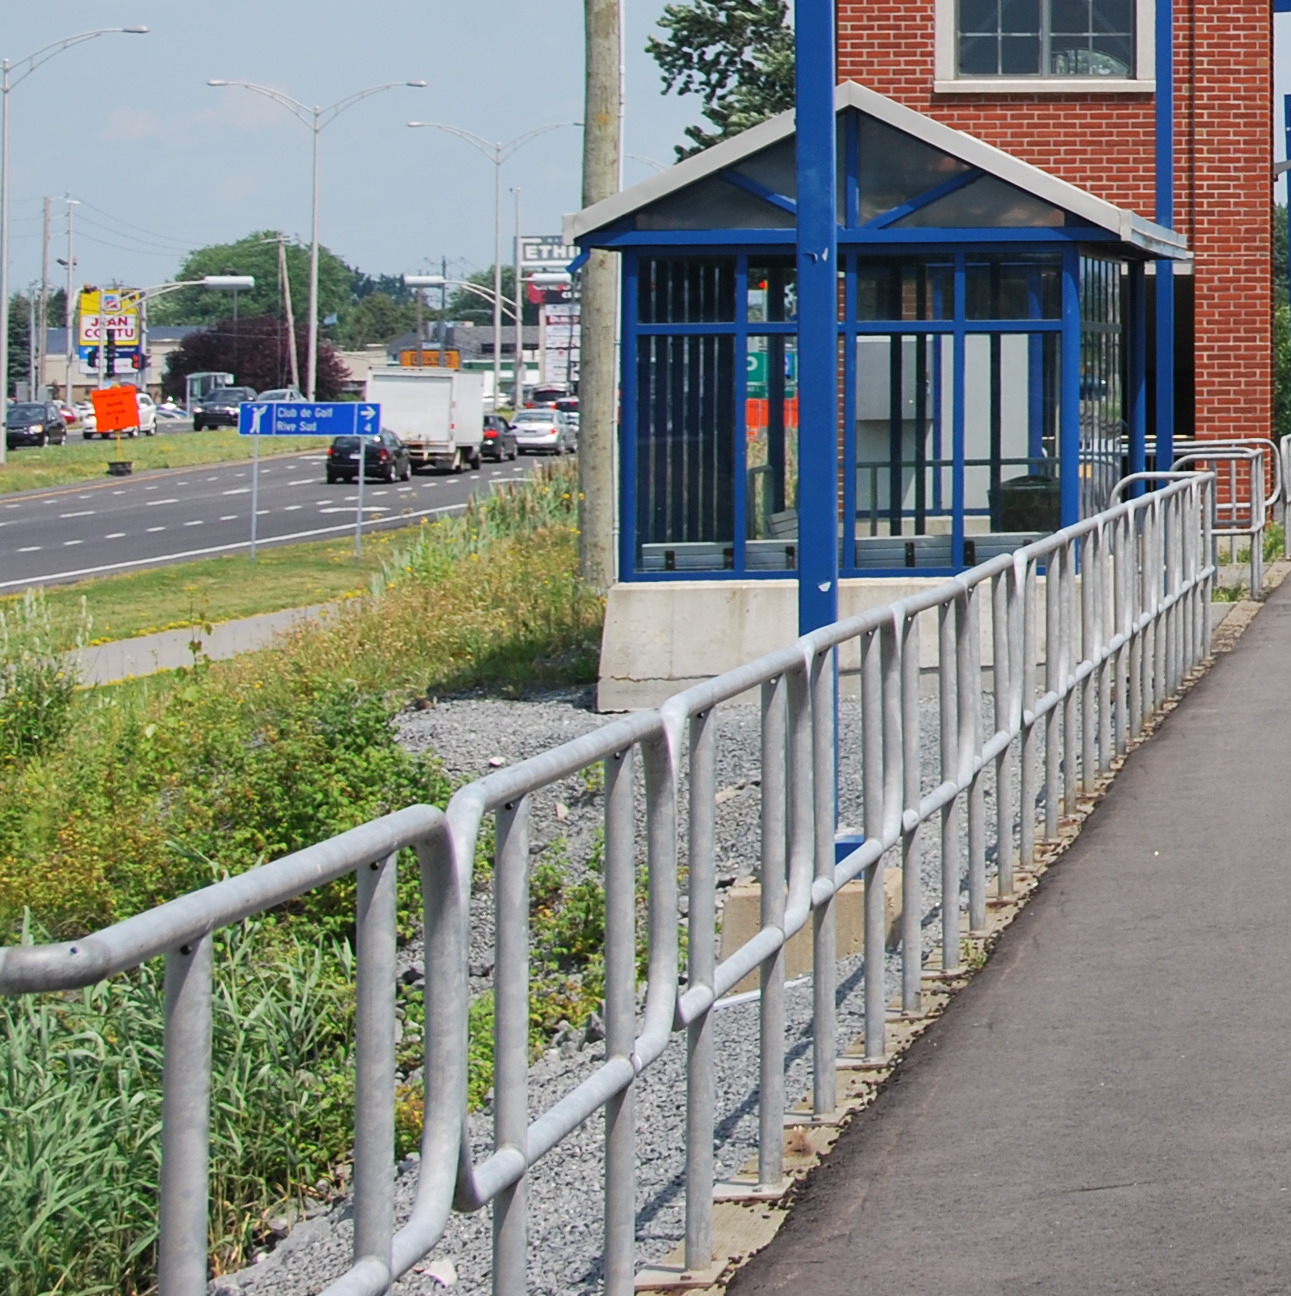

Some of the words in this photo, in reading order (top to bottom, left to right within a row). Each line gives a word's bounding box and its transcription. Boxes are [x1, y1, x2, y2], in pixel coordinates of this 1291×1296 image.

[525, 245, 581, 259] ETHI
[91, 316, 128, 326] JAN
[277, 407, 298, 418] Club
[300, 407, 312, 418] de
[314, 407, 334, 418] Golf
[276, 421, 297, 432] Rive
[298, 421, 318, 432] Sud
[363, 423, 372, 432] 4
